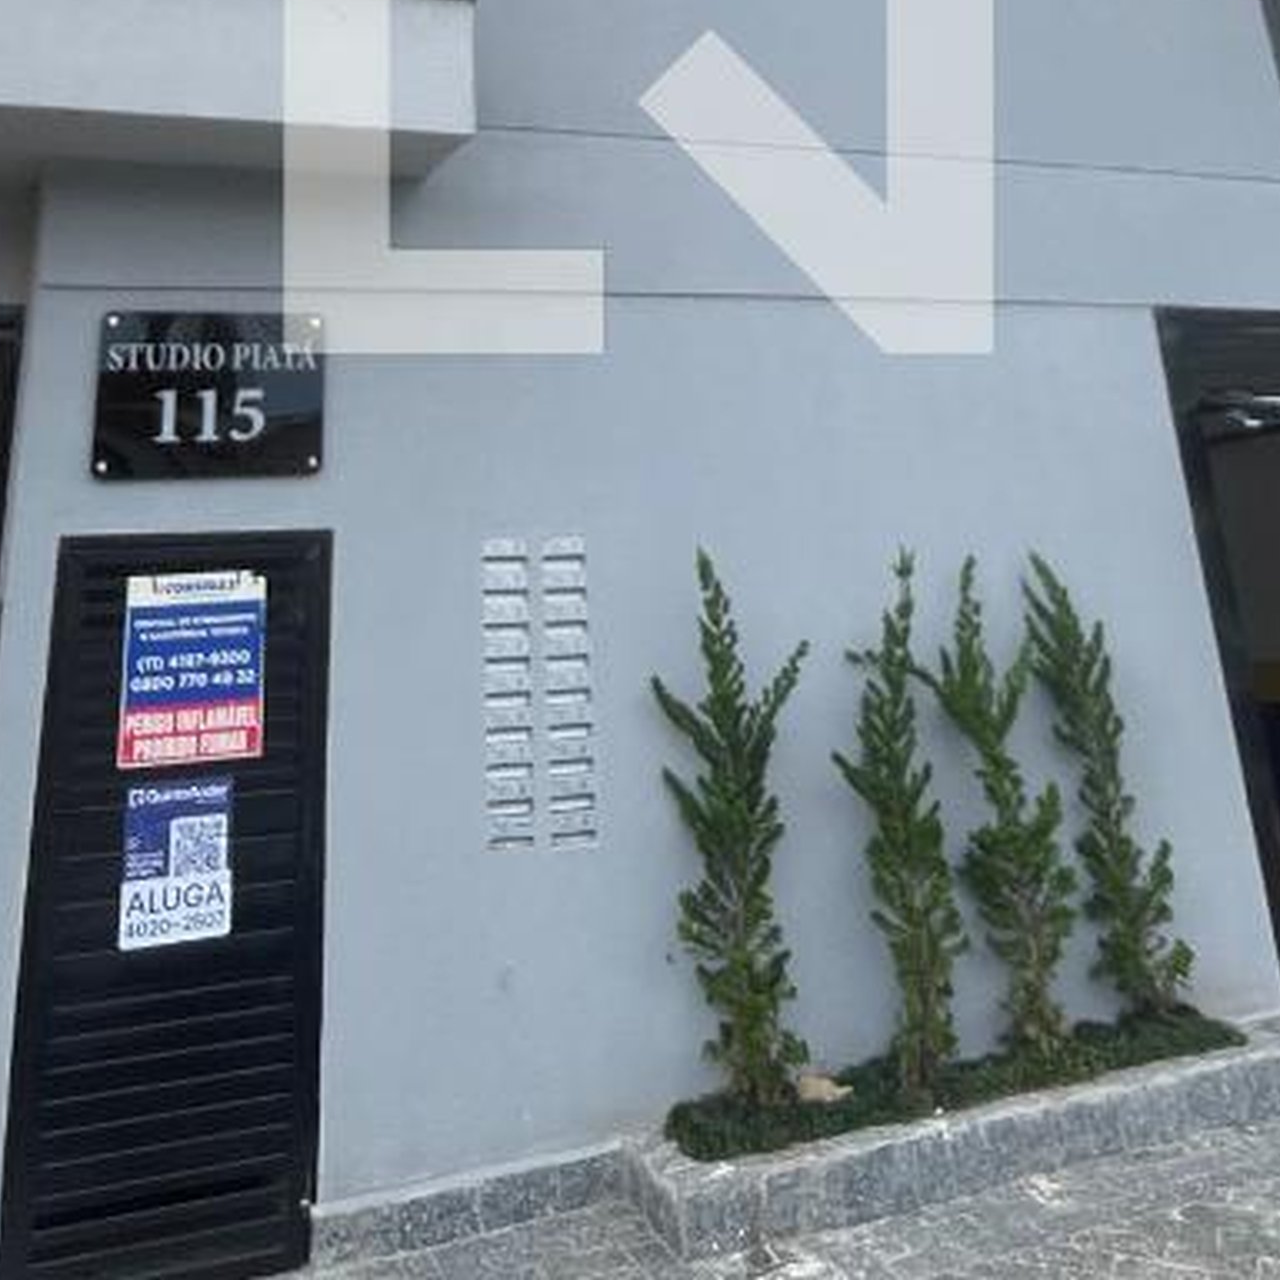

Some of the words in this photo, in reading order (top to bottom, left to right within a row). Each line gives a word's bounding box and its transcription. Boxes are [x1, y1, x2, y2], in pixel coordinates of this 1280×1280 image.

[107, 342, 225, 371] STUDIO
[152, 388, 268, 443] 115
[126, 881, 224, 918] ALUGA
